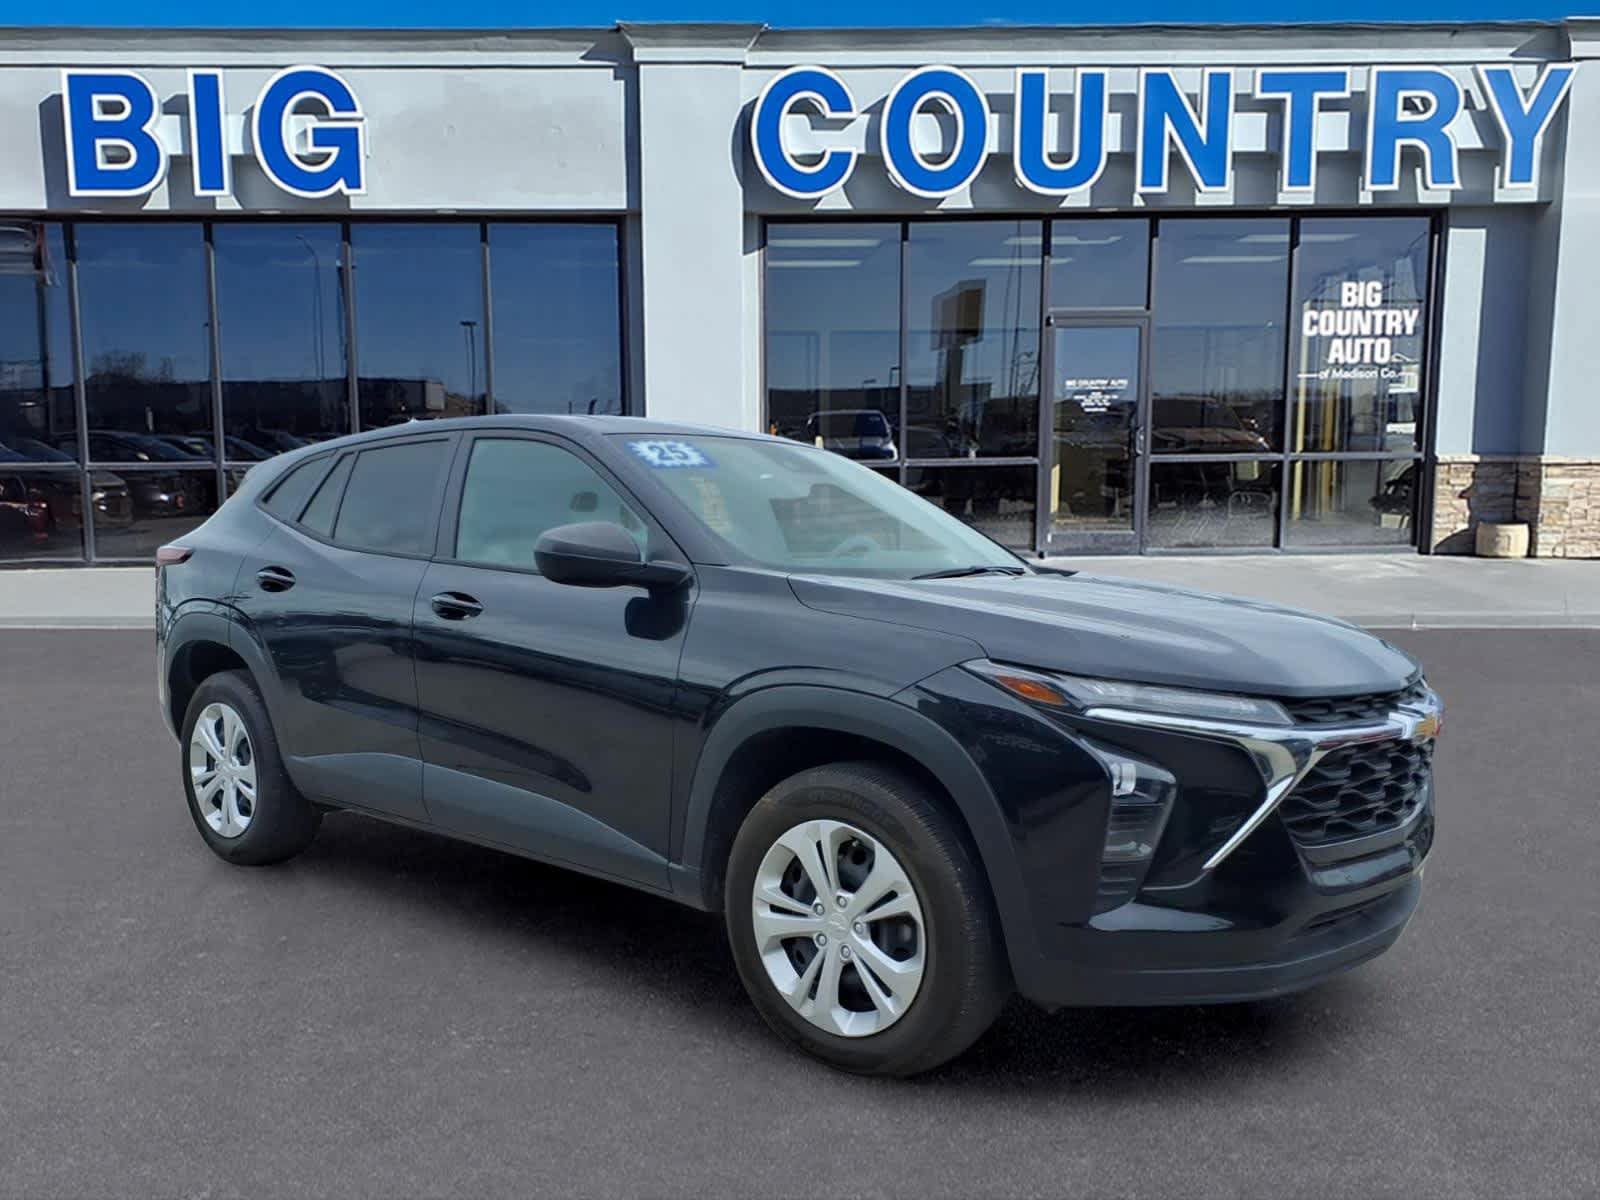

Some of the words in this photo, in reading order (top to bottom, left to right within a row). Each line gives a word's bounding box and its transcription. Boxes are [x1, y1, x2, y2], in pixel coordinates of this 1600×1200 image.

[61, 65, 366, 198] BIG
[749, 63, 1578, 199] COUNTRY
[1341, 281, 1383, 308] BIG
[1302, 309, 1419, 336] COUNTRY
[1327, 337, 1392, 364] AUTO
[1319, 367, 1329, 379] of
[1331, 367, 1379, 379] Madison
[647, 444, 690, 461] 25
